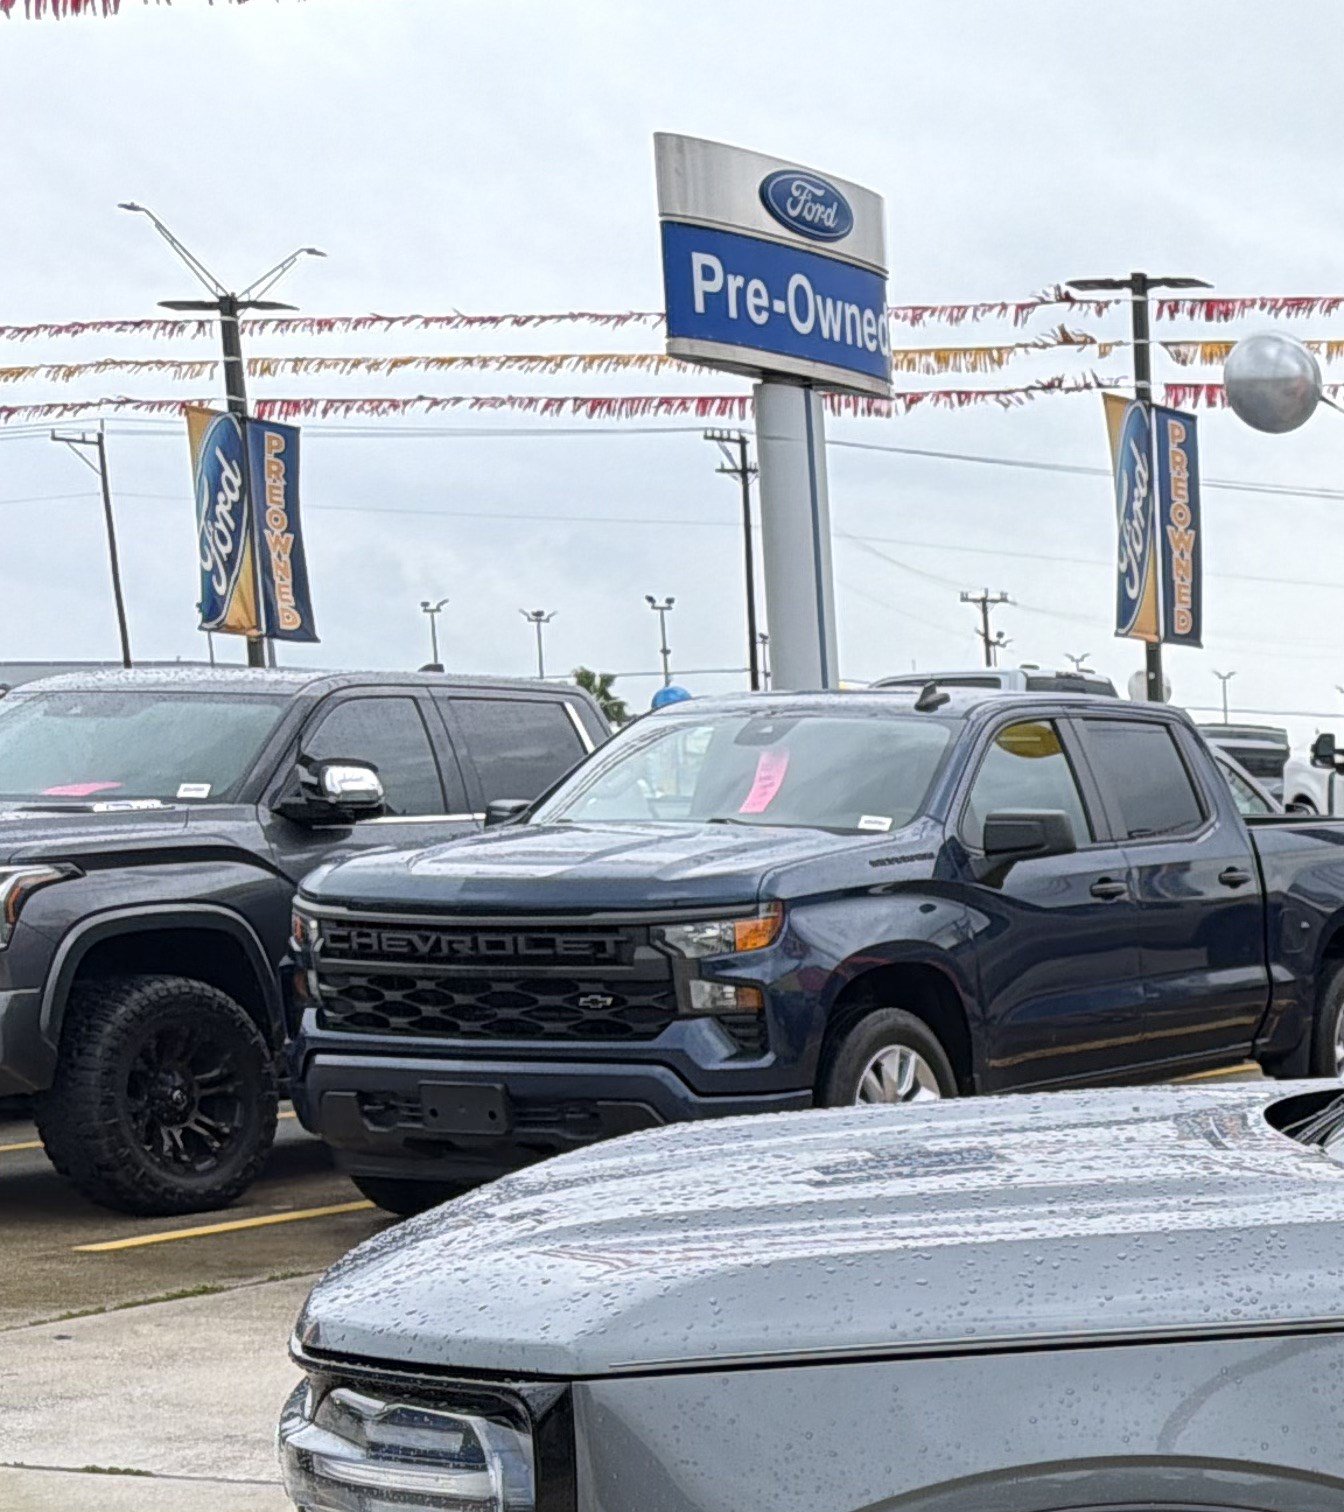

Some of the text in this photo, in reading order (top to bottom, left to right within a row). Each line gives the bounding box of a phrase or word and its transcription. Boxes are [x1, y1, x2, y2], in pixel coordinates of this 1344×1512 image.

[786, 179, 838, 228] Ford
[691, 250, 890, 358] Pre-Owned
[199, 446, 242, 596] Ford
[1118, 437, 1149, 600] Ford
[323, 930, 629, 959] CHEVROLET
